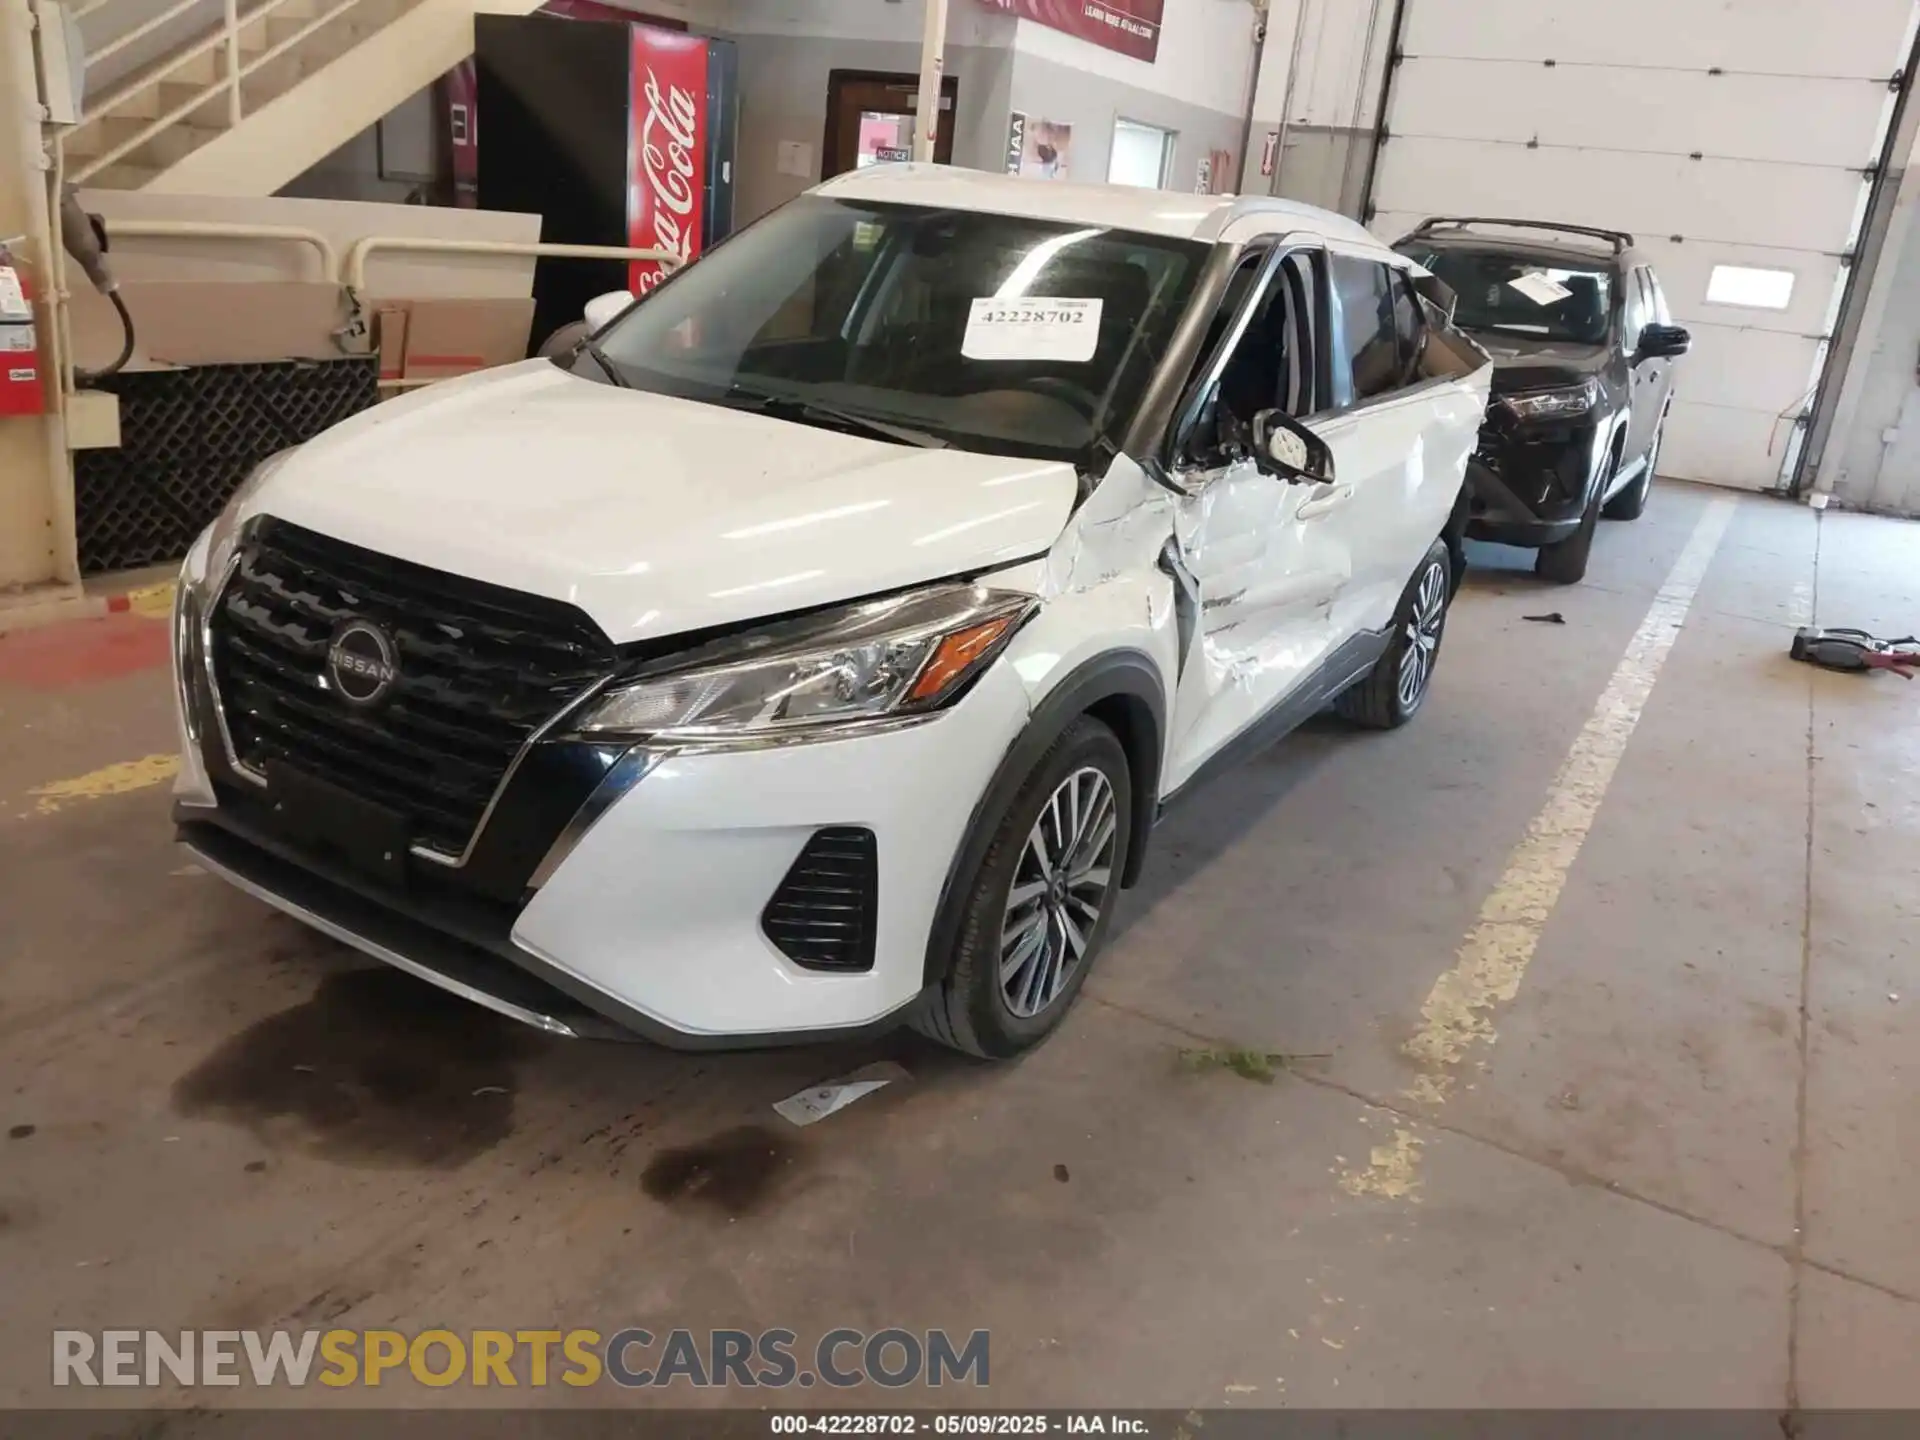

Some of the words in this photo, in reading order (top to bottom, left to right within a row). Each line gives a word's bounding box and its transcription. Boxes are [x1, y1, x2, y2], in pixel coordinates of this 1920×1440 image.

[1084, 4, 1105, 21] LEARN
[1010, 119, 1023, 156] IAA
[878, 149, 907, 161] NOTICE
[981, 311, 1084, 324] 42228702
[329, 646, 394, 681] NISSAN
